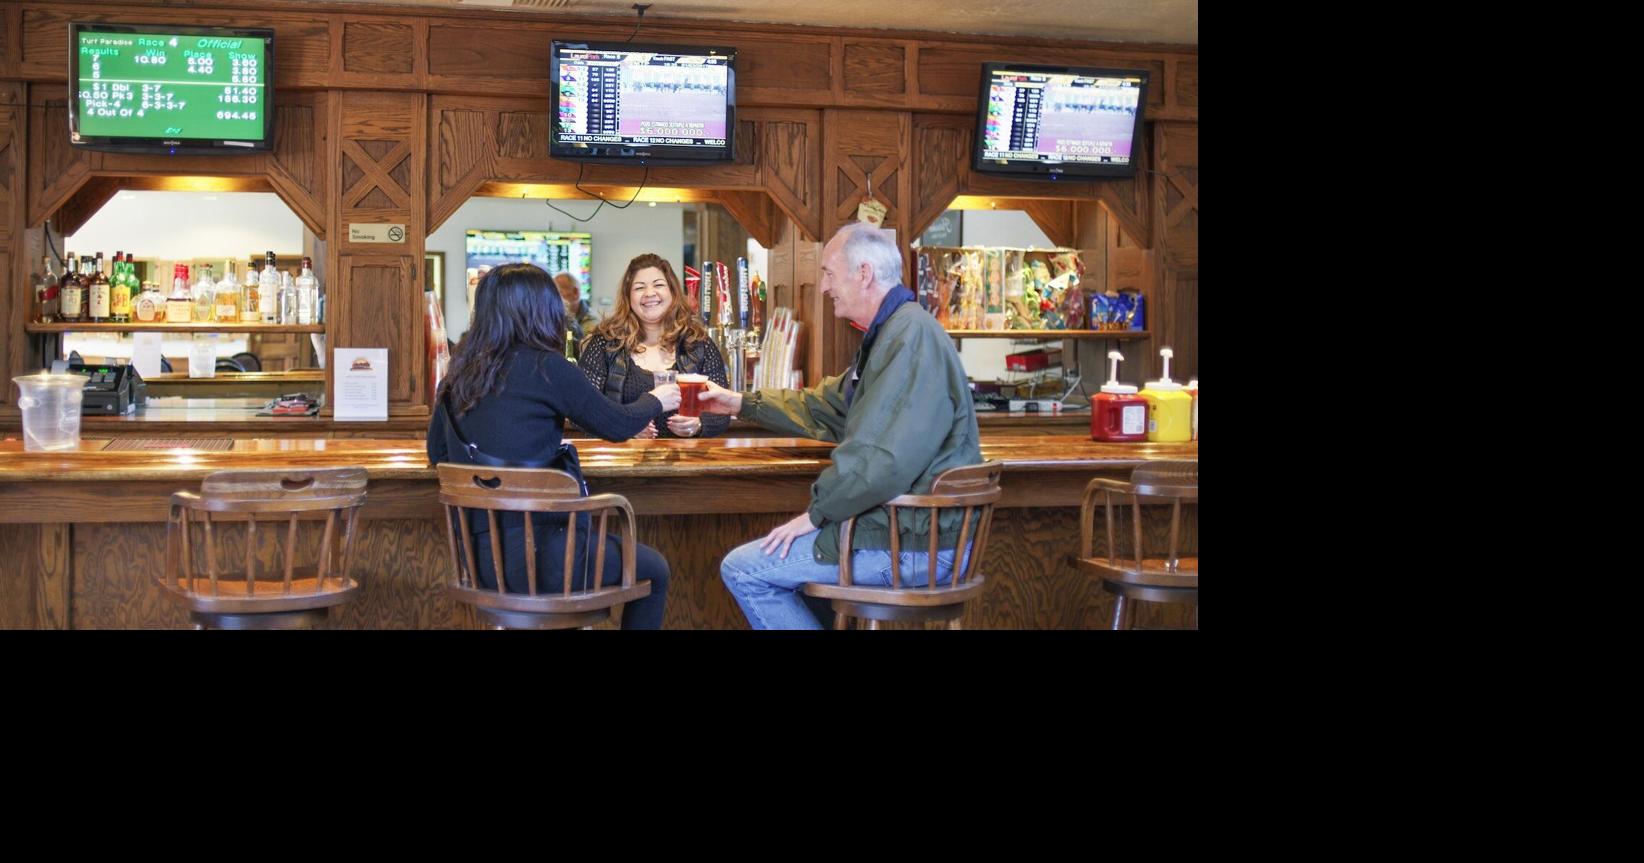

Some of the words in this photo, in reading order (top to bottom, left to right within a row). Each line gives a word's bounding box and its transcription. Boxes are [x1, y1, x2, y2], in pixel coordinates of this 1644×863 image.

[138, 38, 164, 46] Race
[169, 38, 178, 47] 4
[198, 38, 242, 48] Official
[81, 47, 118, 56] Results
[184, 50, 212, 58] Place
[228, 52, 256, 60] Show
[188, 66, 213, 74] 4.40
[142, 84, 161, 92] 3-7
[142, 92, 174, 101] 3-3-7
[86, 100, 121, 108] Pick-4
[137, 109, 144, 117] 4
